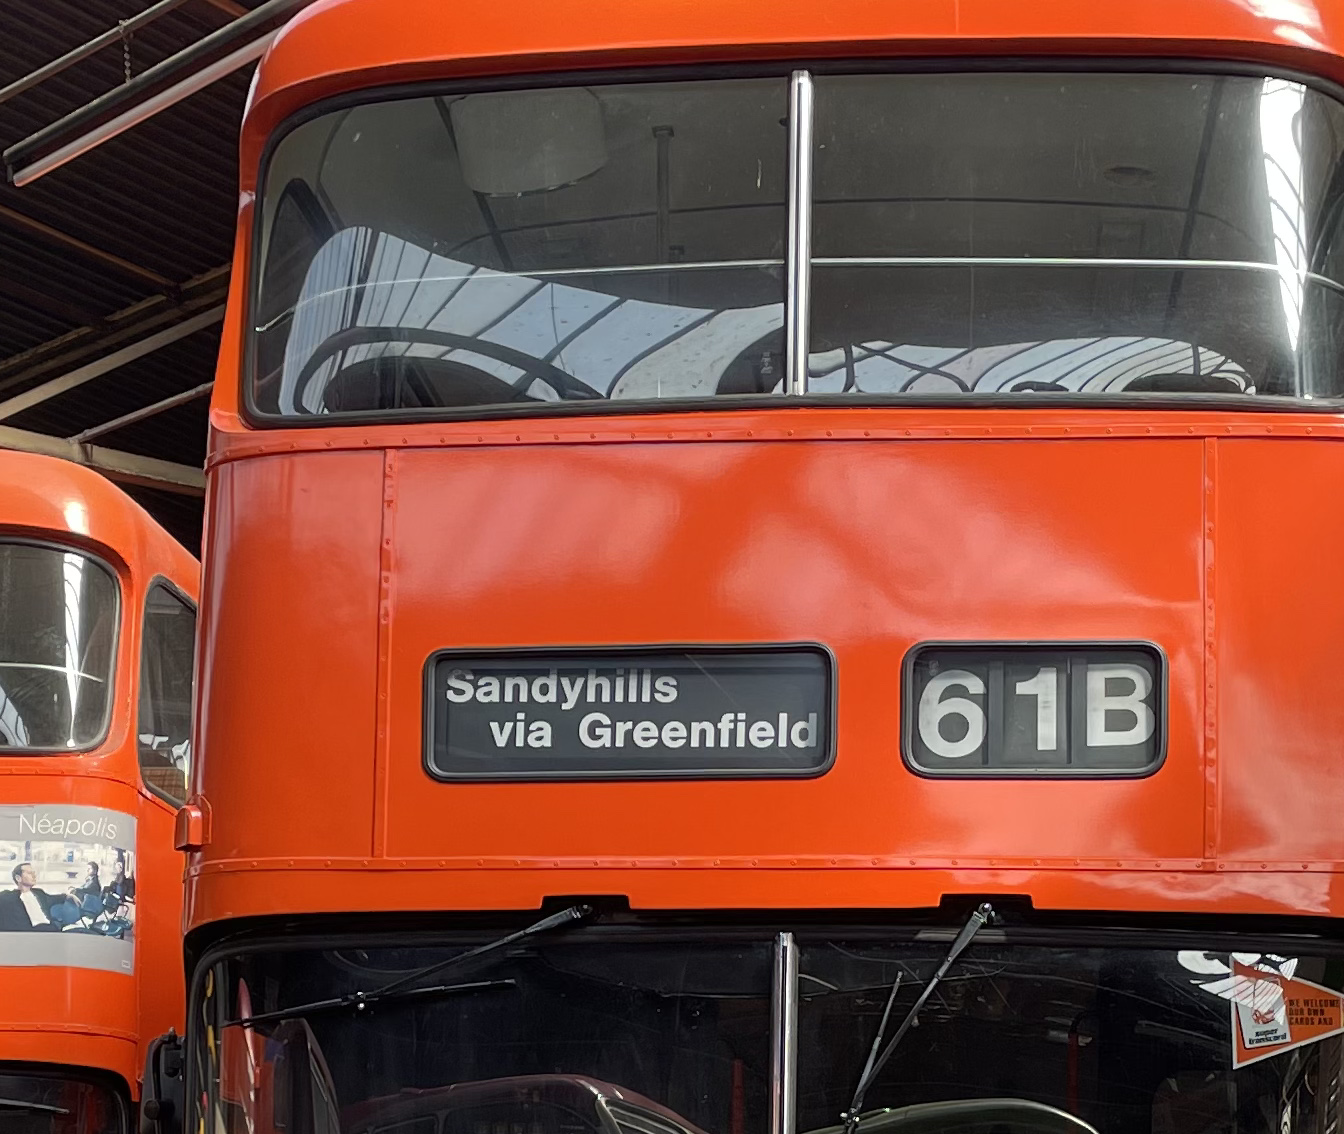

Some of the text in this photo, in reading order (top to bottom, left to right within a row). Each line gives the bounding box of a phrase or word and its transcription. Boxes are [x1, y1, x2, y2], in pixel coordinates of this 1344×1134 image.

[446, 668, 679, 710] Sandyhills
[918, 663, 1157, 758] 61B
[489, 712, 818, 749] via Greenfield
[18, 813, 118, 840] Néapolis
